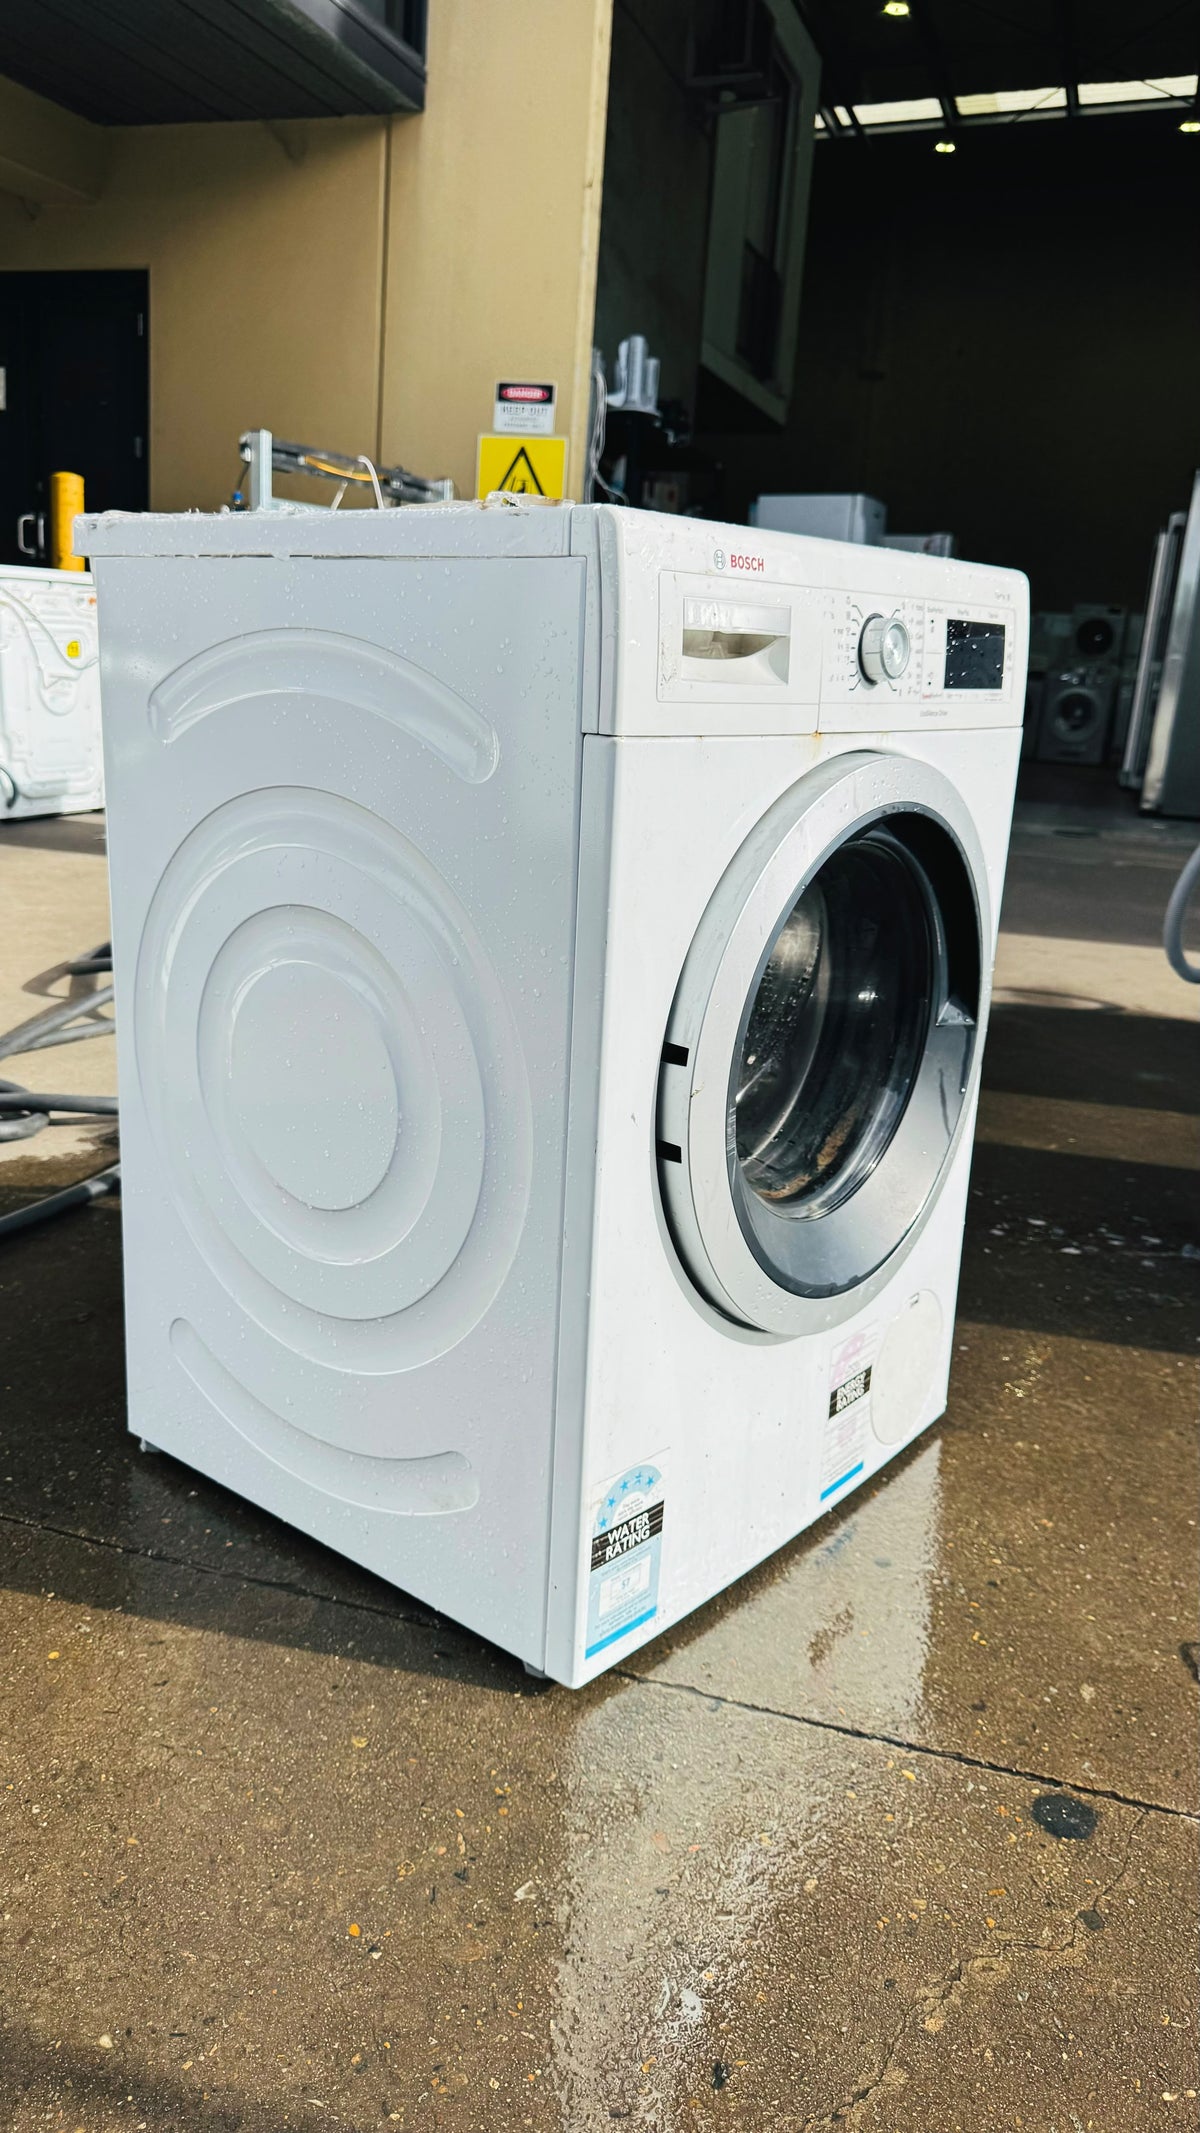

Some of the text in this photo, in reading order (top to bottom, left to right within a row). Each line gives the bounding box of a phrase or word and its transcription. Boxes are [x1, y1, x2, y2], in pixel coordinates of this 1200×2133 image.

[730, 554, 765, 572] BOSCH
[836, 1371, 867, 1400] ENERGY
[605, 1524, 651, 1561] RATING
[607, 1512, 650, 1545] WATER
